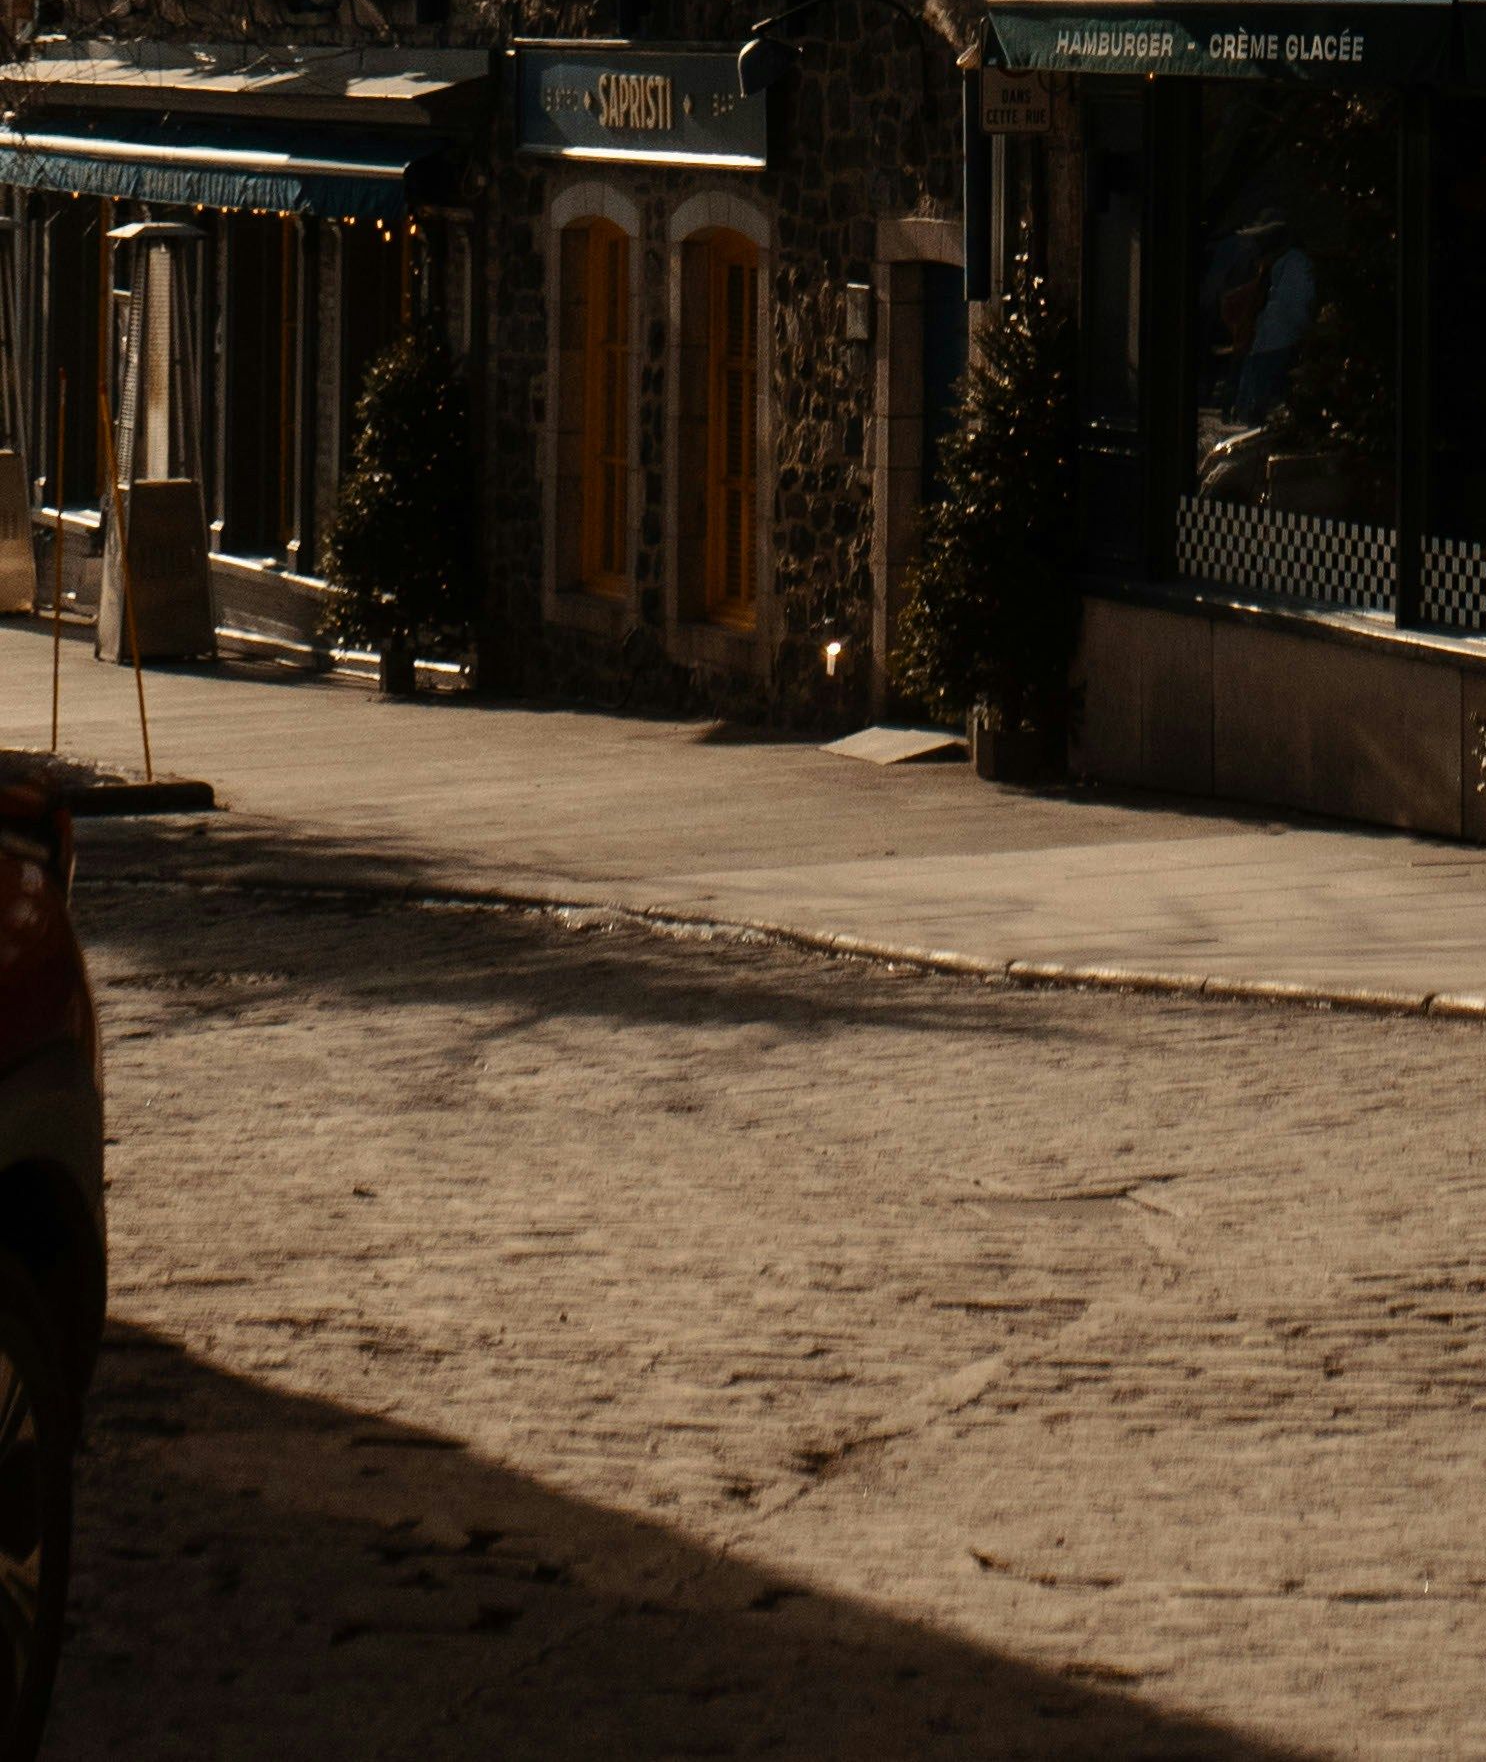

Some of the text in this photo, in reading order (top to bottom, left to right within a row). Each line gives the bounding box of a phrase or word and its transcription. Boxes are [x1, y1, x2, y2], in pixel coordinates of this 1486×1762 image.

[1056, 29, 1173, 58] HAMBURGER
[1209, 27, 1278, 60] CRÈME
[1285, 27, 1364, 62] GLACÉE
[598, 74, 673, 131] SAPRISTI
[1001, 88, 1031, 104] DANS
[986, 108, 1046, 124] CETTE RUE
